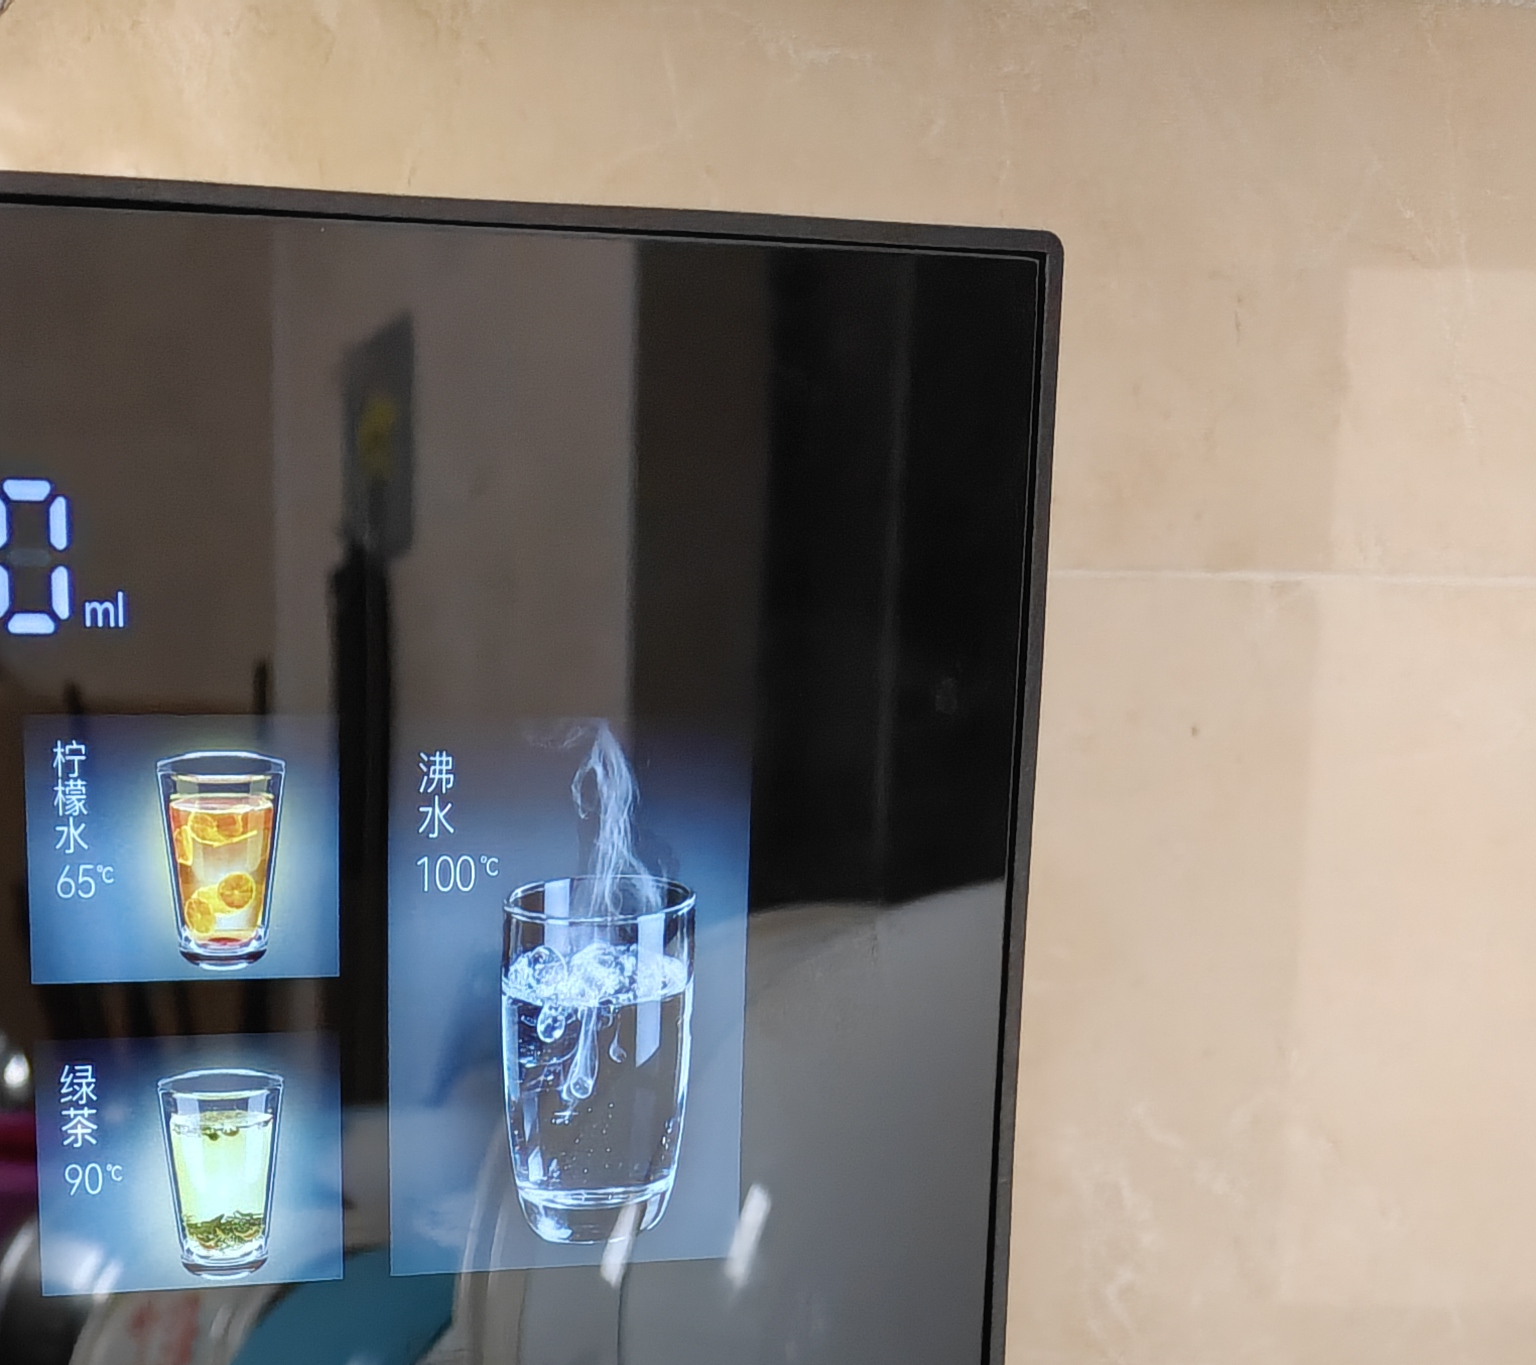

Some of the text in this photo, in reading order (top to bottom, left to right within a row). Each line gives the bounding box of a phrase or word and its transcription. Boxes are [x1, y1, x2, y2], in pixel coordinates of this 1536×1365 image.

[52, 740, 89, 854] 柠檬水
[417, 751, 456, 839] 沸水
[60, 1064, 98, 1149] 绿茶
